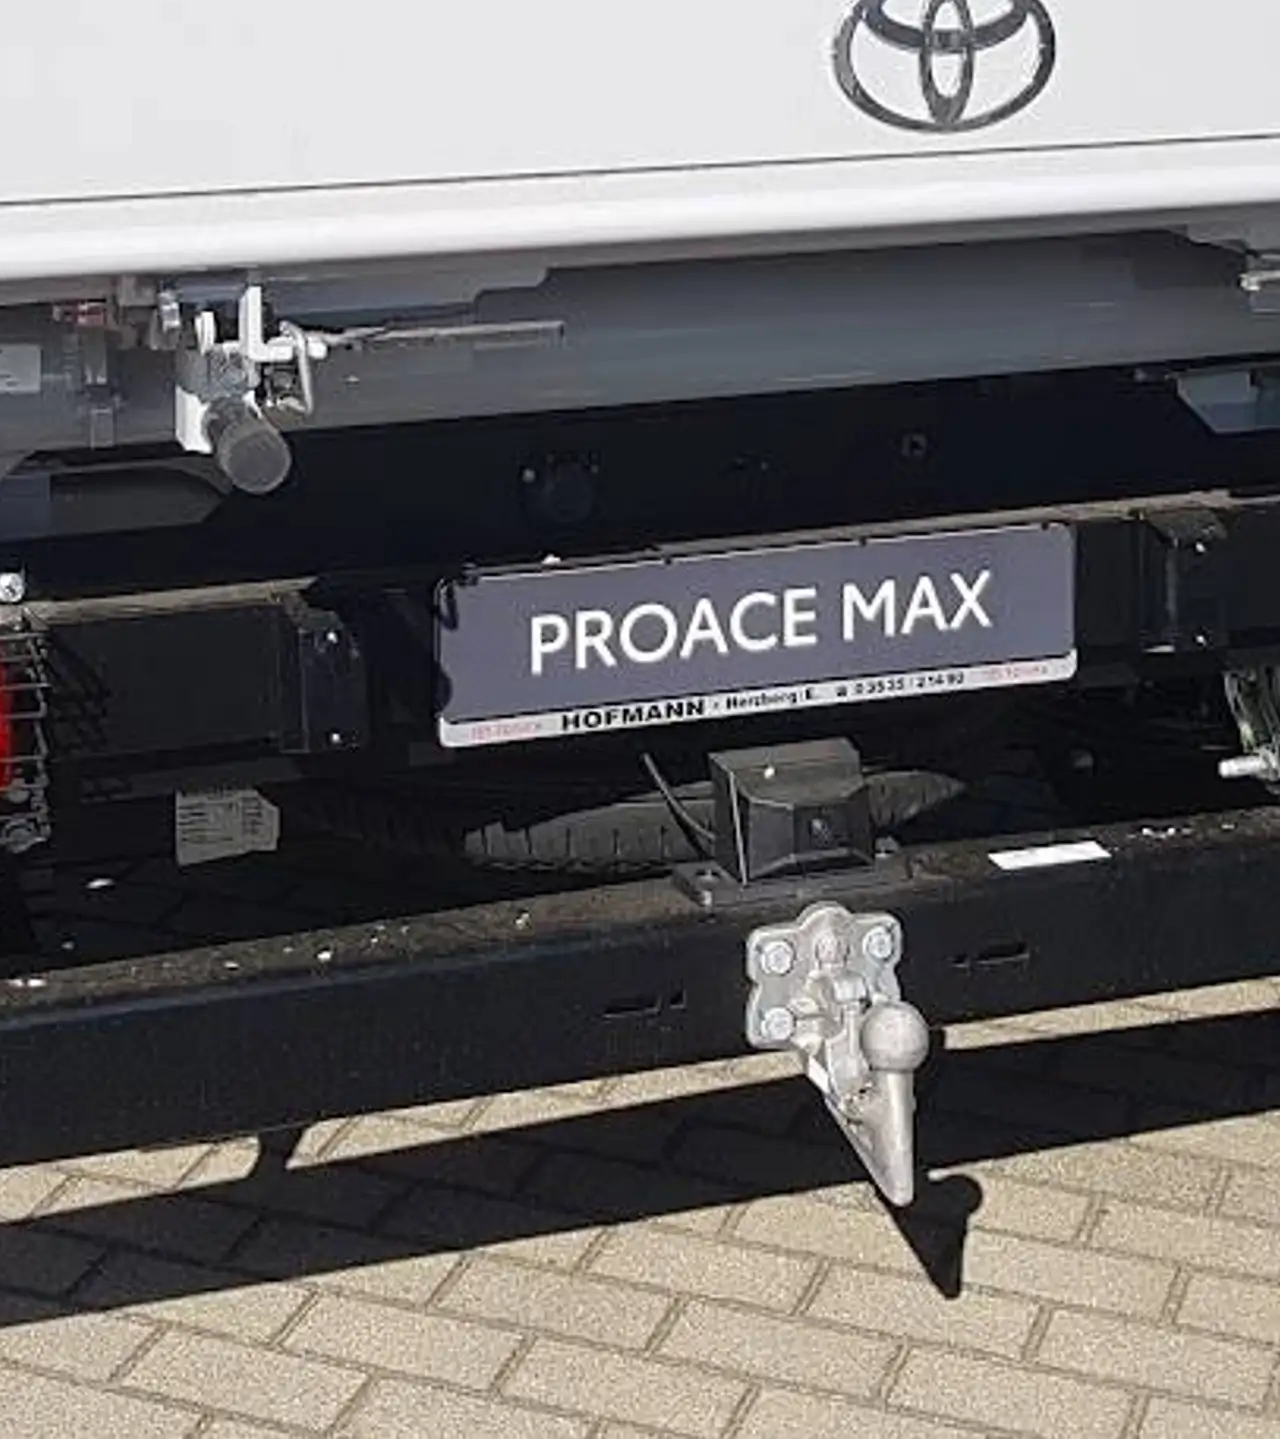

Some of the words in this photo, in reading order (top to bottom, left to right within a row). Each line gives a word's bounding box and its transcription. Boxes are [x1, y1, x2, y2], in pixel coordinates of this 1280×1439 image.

[530, 587, 818, 676] PROACE
[840, 569, 993, 641] MAX
[561, 698, 706, 731] HOFMANN
